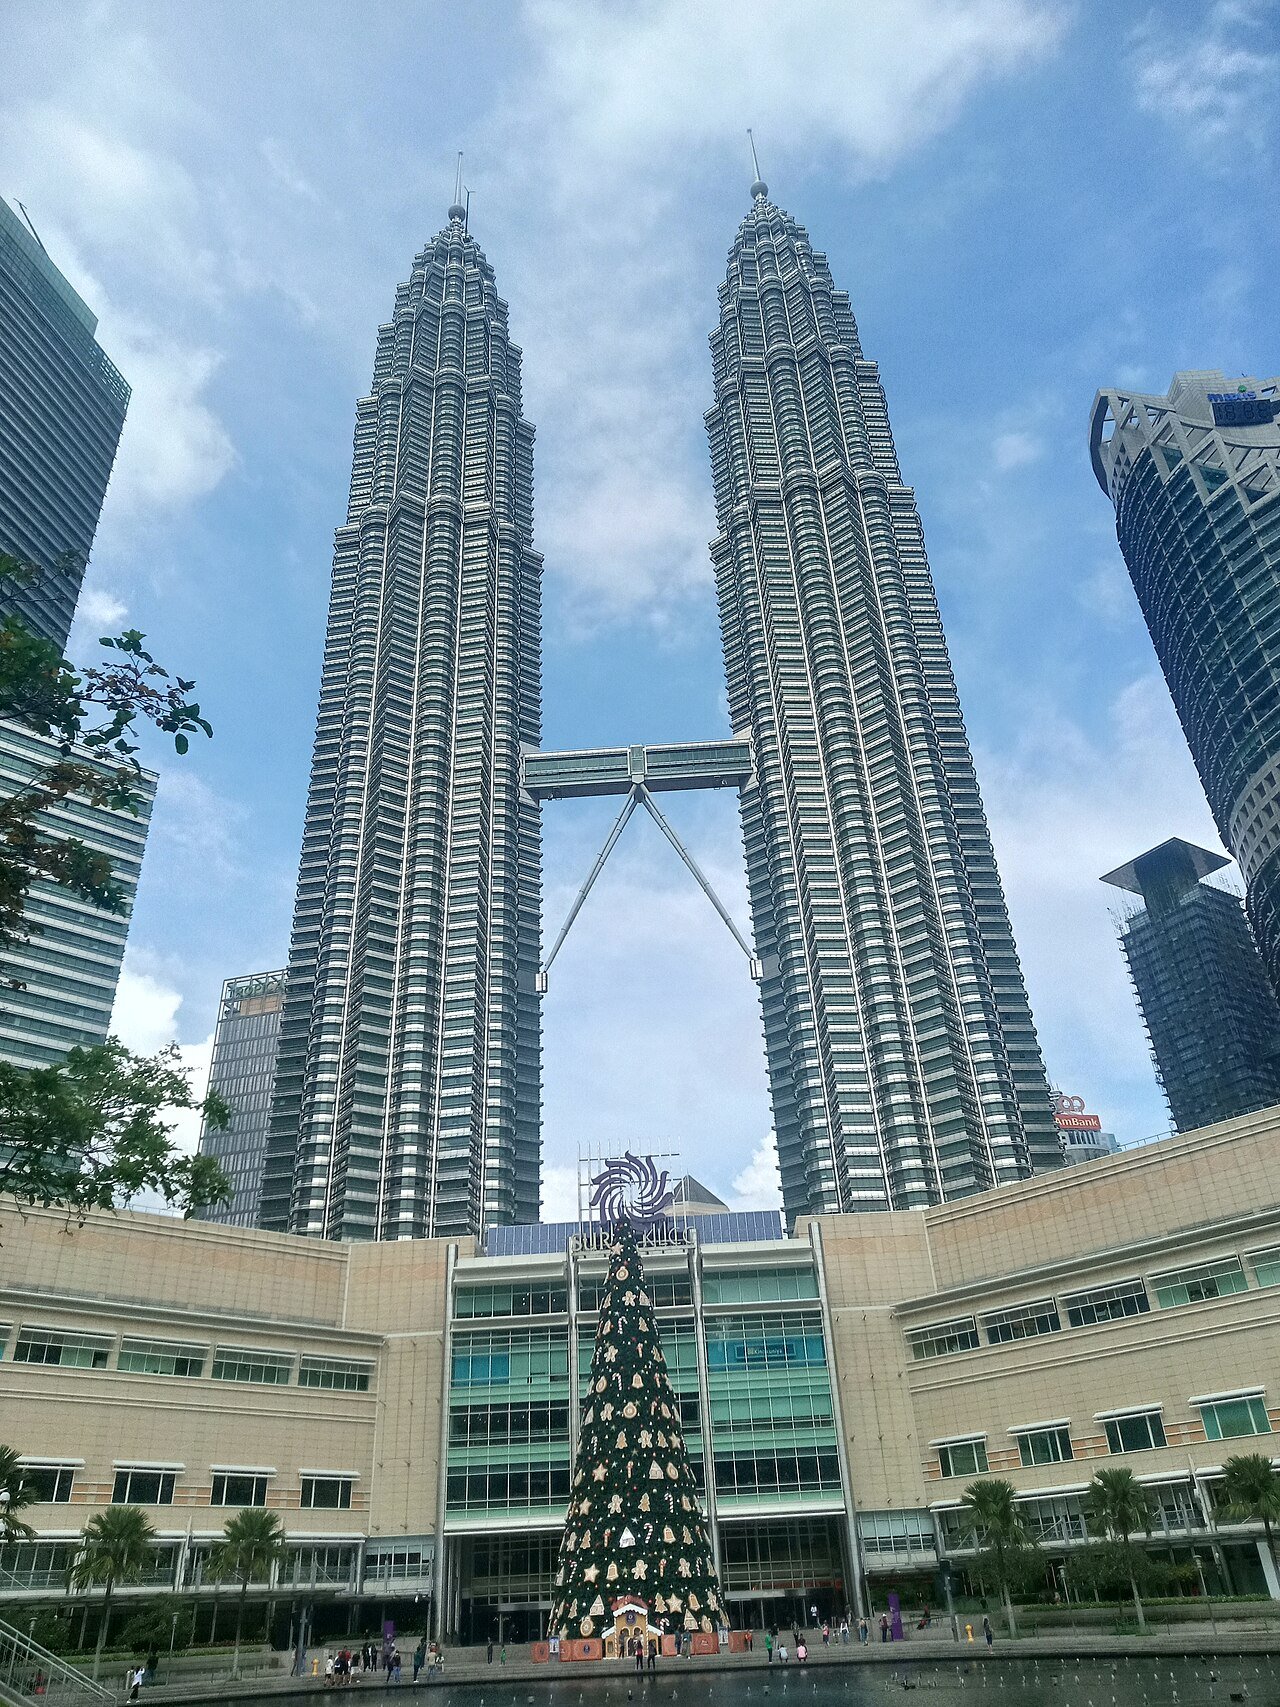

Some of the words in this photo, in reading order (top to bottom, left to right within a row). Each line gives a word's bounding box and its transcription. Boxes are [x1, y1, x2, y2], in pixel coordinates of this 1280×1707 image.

[1055, 1117, 1098, 1126] AmBank
[571, 1229, 613, 1251] SUR
[643, 1226, 695, 1248] KLCC
